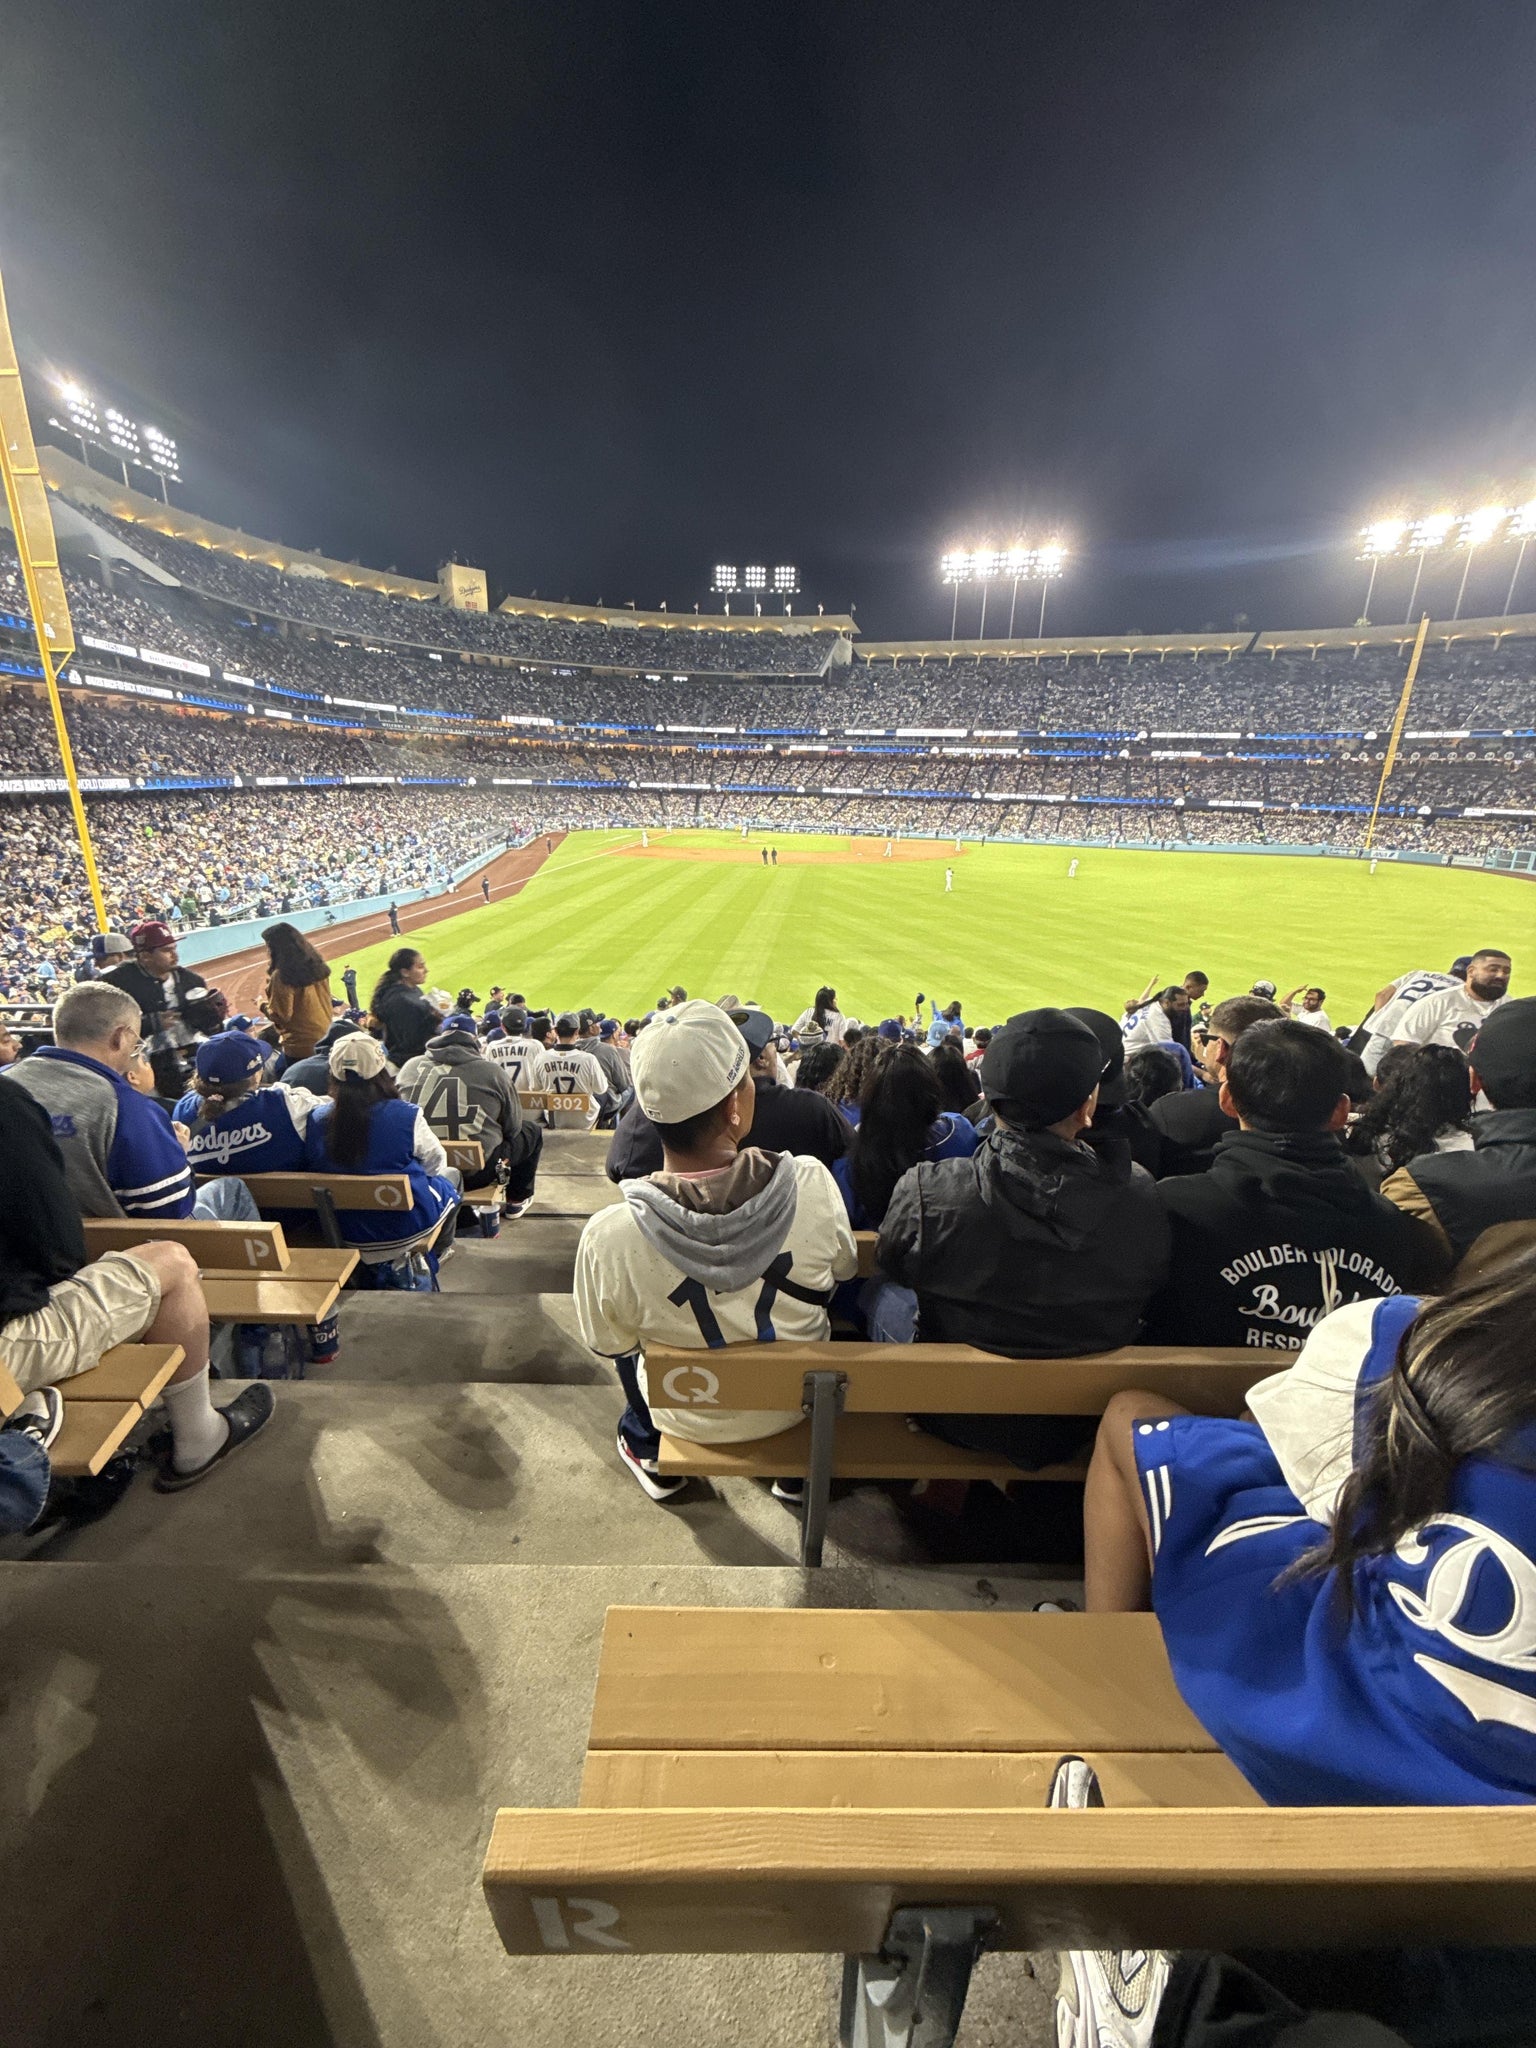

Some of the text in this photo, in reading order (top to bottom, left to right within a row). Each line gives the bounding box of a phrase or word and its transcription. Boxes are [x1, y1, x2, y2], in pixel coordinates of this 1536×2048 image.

[491, 1045, 528, 1059] OHTANI
[544, 1060, 580, 1074] OHTANI
[553, 1076, 576, 1094] 17
[530, 1097, 544, 1108] M
[553, 1097, 582, 1110] 302
[453, 1149, 475, 1167] N
[374, 1184, 402, 1207] O
[244, 1238, 270, 1267] P
[662, 1366, 720, 1404] Q
[531, 1897, 632, 1949] R
